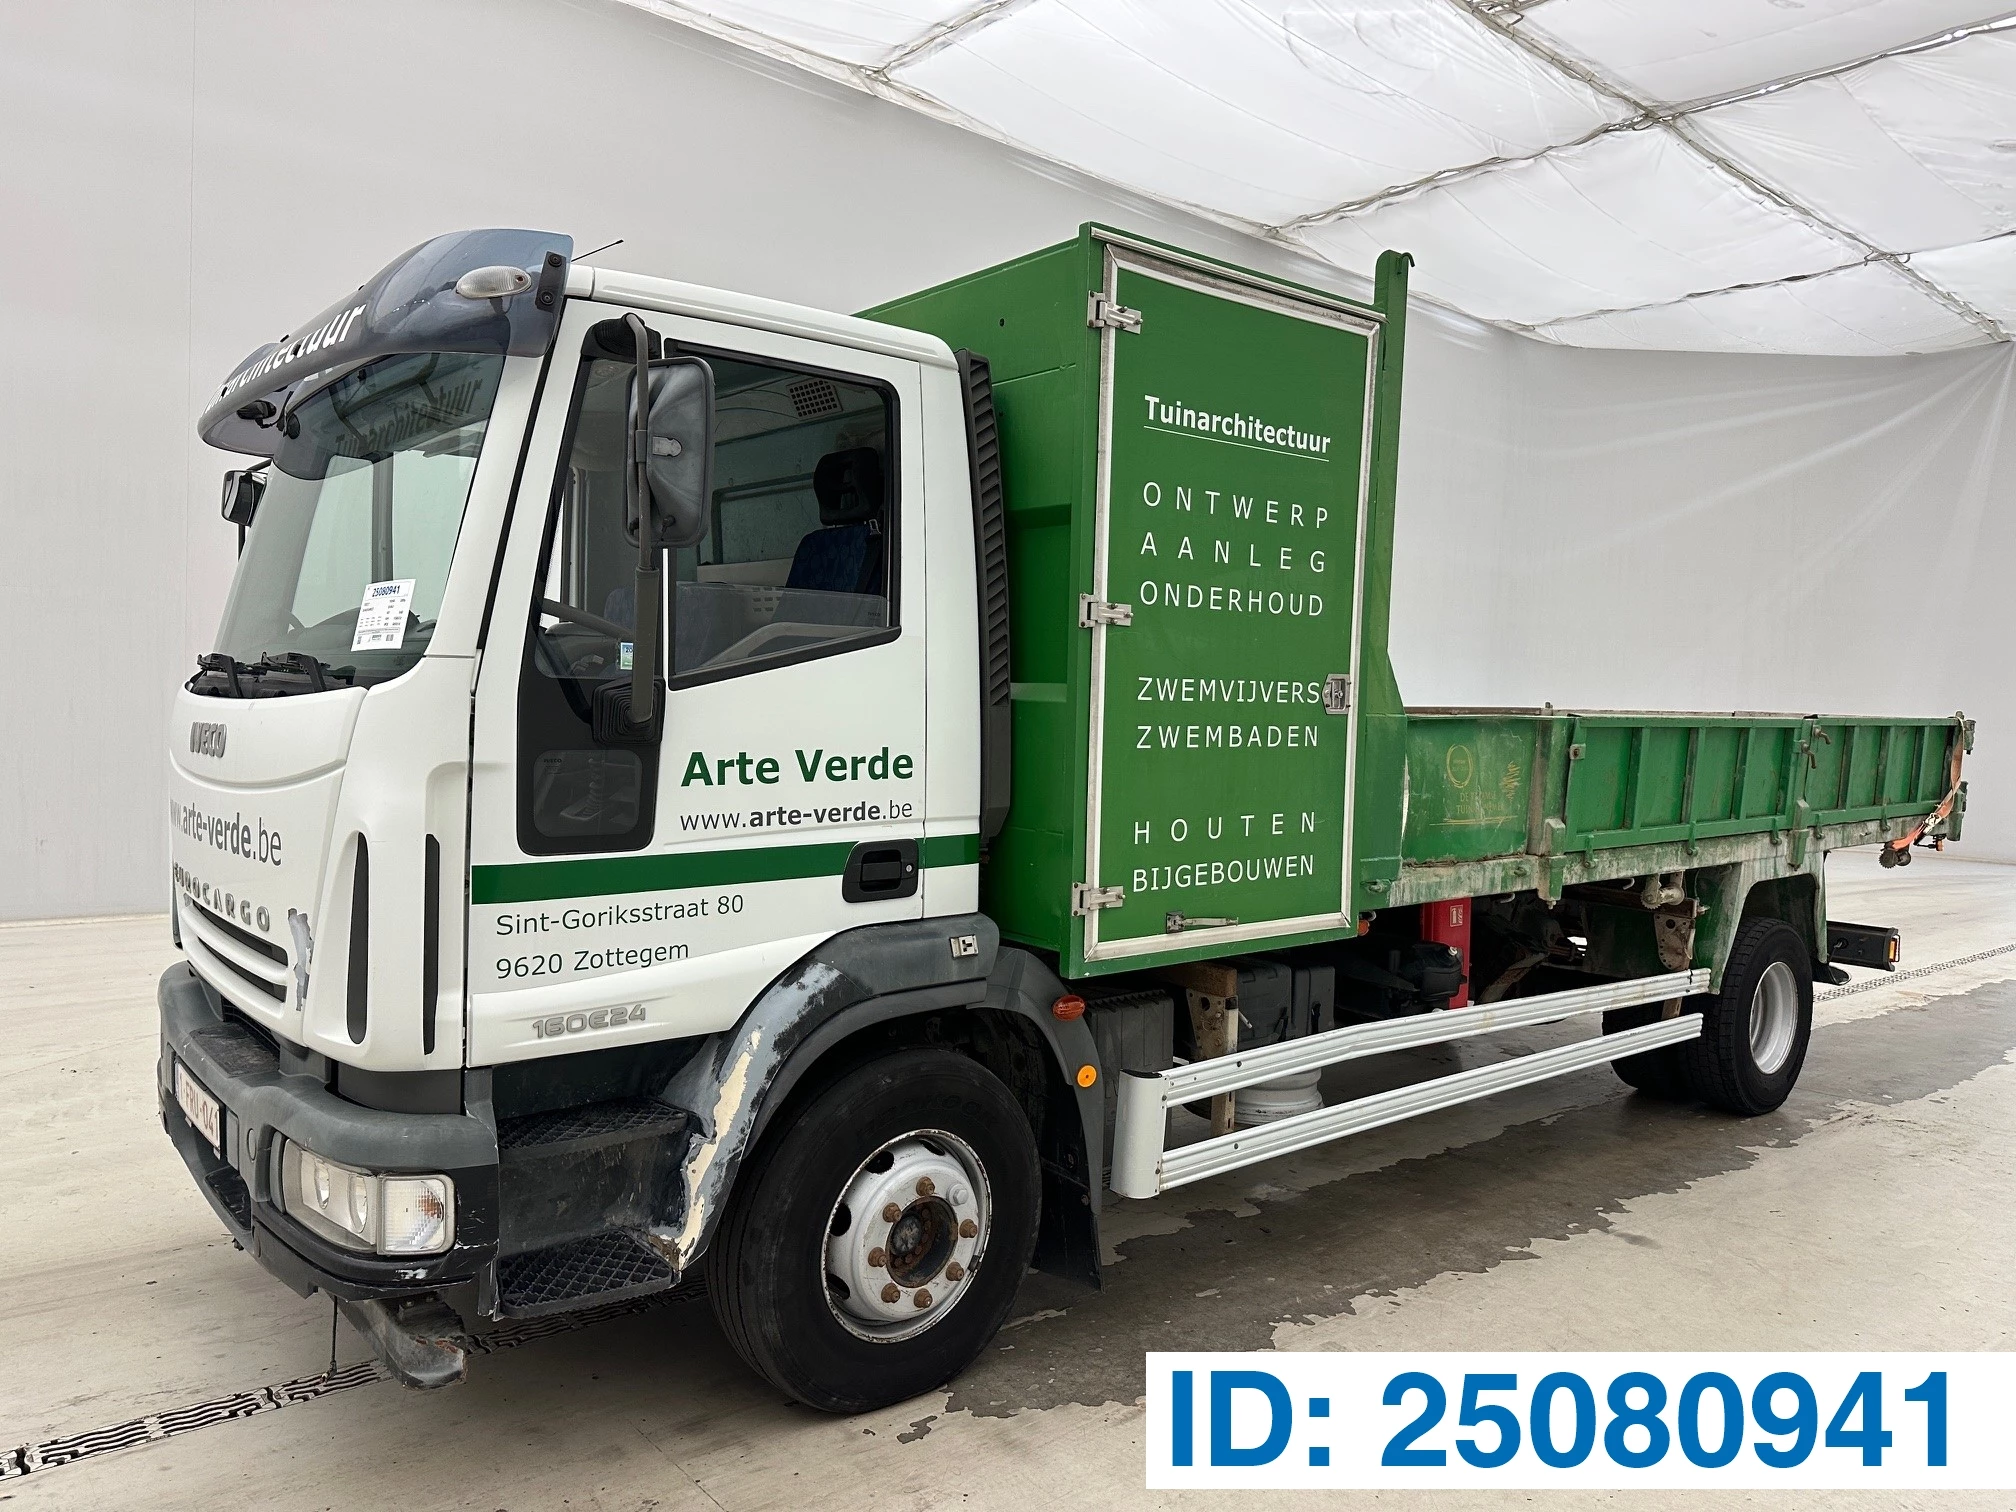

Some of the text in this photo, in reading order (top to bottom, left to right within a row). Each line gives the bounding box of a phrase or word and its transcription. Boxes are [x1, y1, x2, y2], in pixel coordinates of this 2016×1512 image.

[1144, 394, 1330, 453] Tuinarchitectuur
[1143, 481, 1328, 529] ONTWERP
[1140, 531, 1325, 573] AANLEG
[372, 585, 400, 597] 25080941
[1140, 580, 1323, 616] ONDERHOUD
[1137, 676, 1321, 704] ZWEMVIJVERS
[190, 721, 227, 758] IVECO
[1136, 725, 1319, 749] ZWEMBADEN
[680, 746, 914, 788] Arte Verde
[680, 799, 913, 831] www.arte-verde.be
[1134, 811, 1315, 845] HOUTEN
[1133, 854, 1314, 893] BIJGEBOUWEN
[496, 894, 744, 936] Sint-Goriksstraat 80
[496, 942, 690, 980] 9620 Zottegem
[532, 1003, 646, 1039] 160E24
